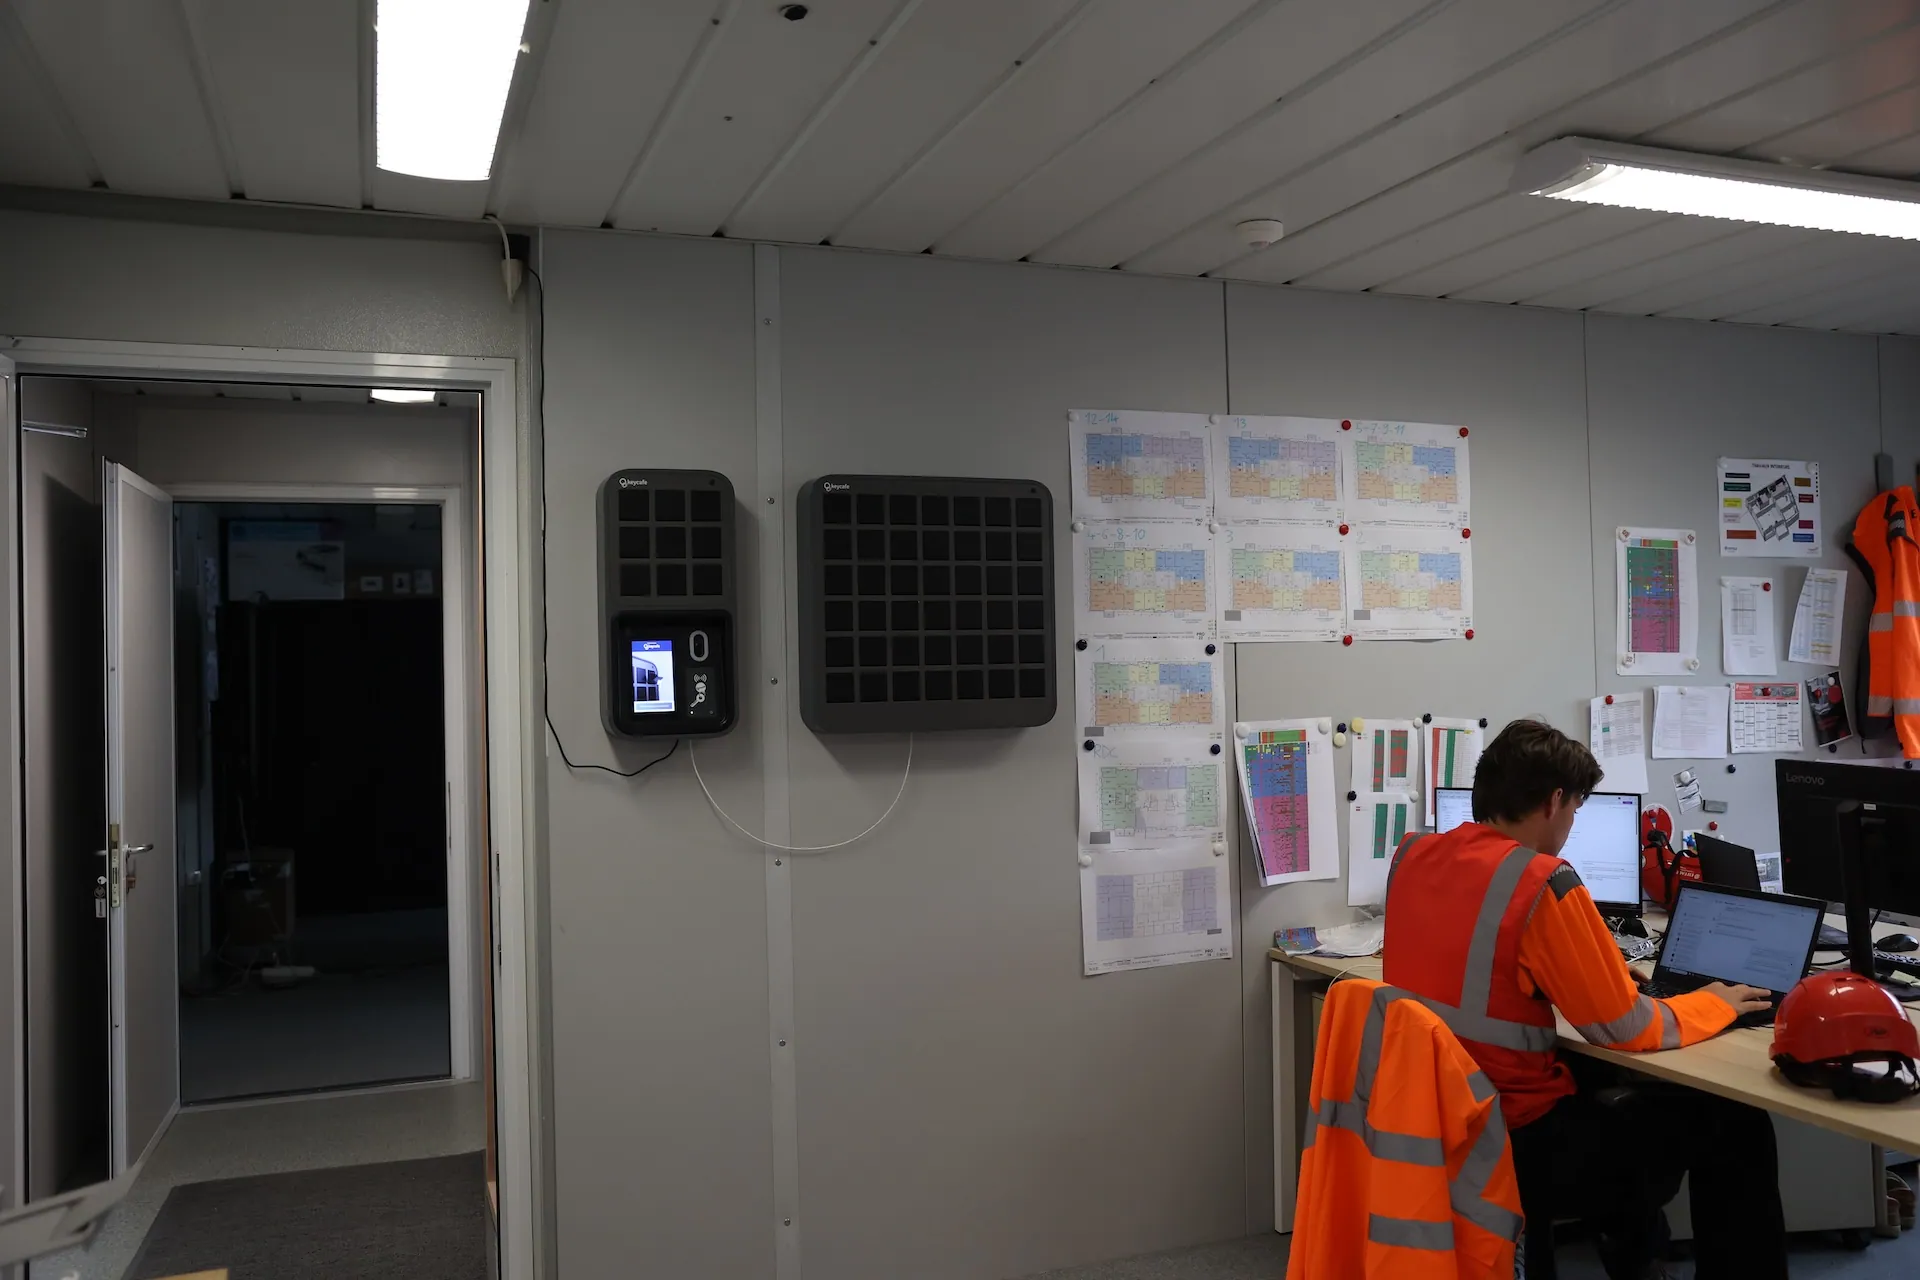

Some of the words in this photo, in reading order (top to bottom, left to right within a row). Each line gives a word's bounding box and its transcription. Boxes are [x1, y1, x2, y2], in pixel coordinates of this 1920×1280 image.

[1084, 412, 1119, 425] 12-14
[1234, 418, 1247, 429] 13
[627, 479, 648, 487] keycafe
[1225, 530, 1234, 544] 3
[1356, 531, 1367, 544] 2
[1785, 772, 1825, 786] Lenovo
